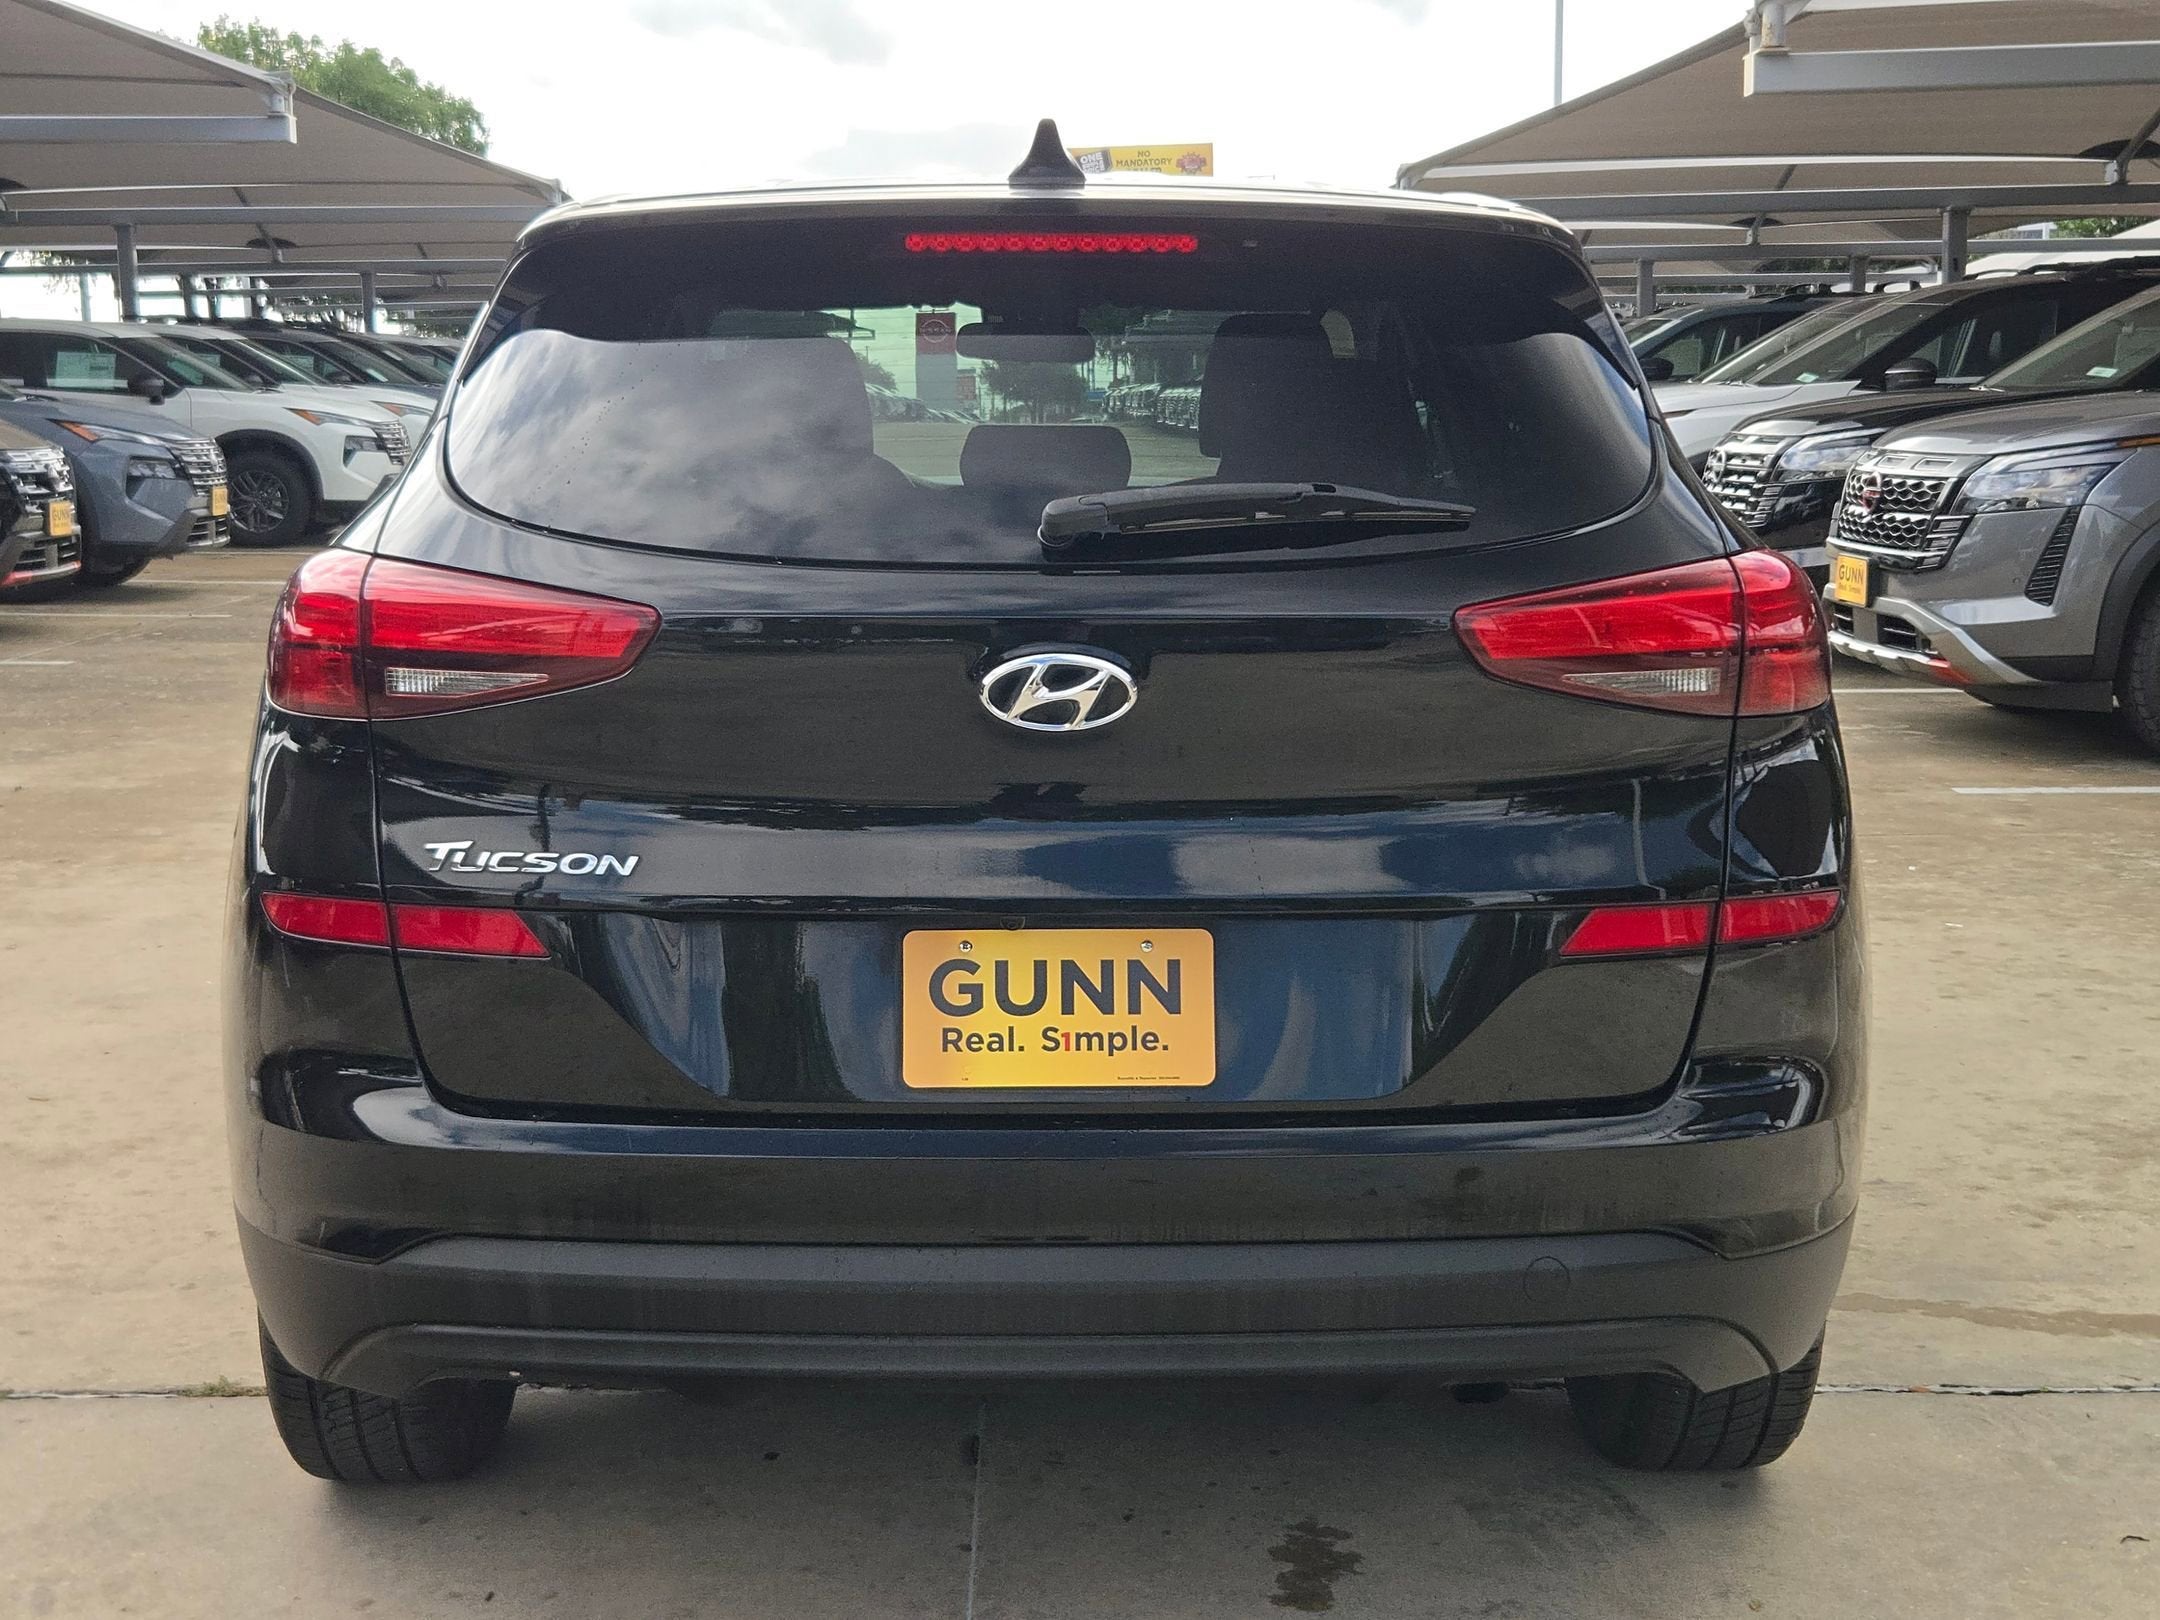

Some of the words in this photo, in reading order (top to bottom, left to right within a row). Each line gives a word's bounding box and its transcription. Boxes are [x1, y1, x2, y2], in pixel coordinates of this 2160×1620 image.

[1116, 158, 1172, 167] MANDATORY
[1137, 150, 1151, 158] NO
[1838, 564, 1864, 585] GUNN
[424, 840, 640, 876] TUCSON
[928, 958, 1182, 1018] GUNN
[941, 1026, 1025, 1053] Real.
